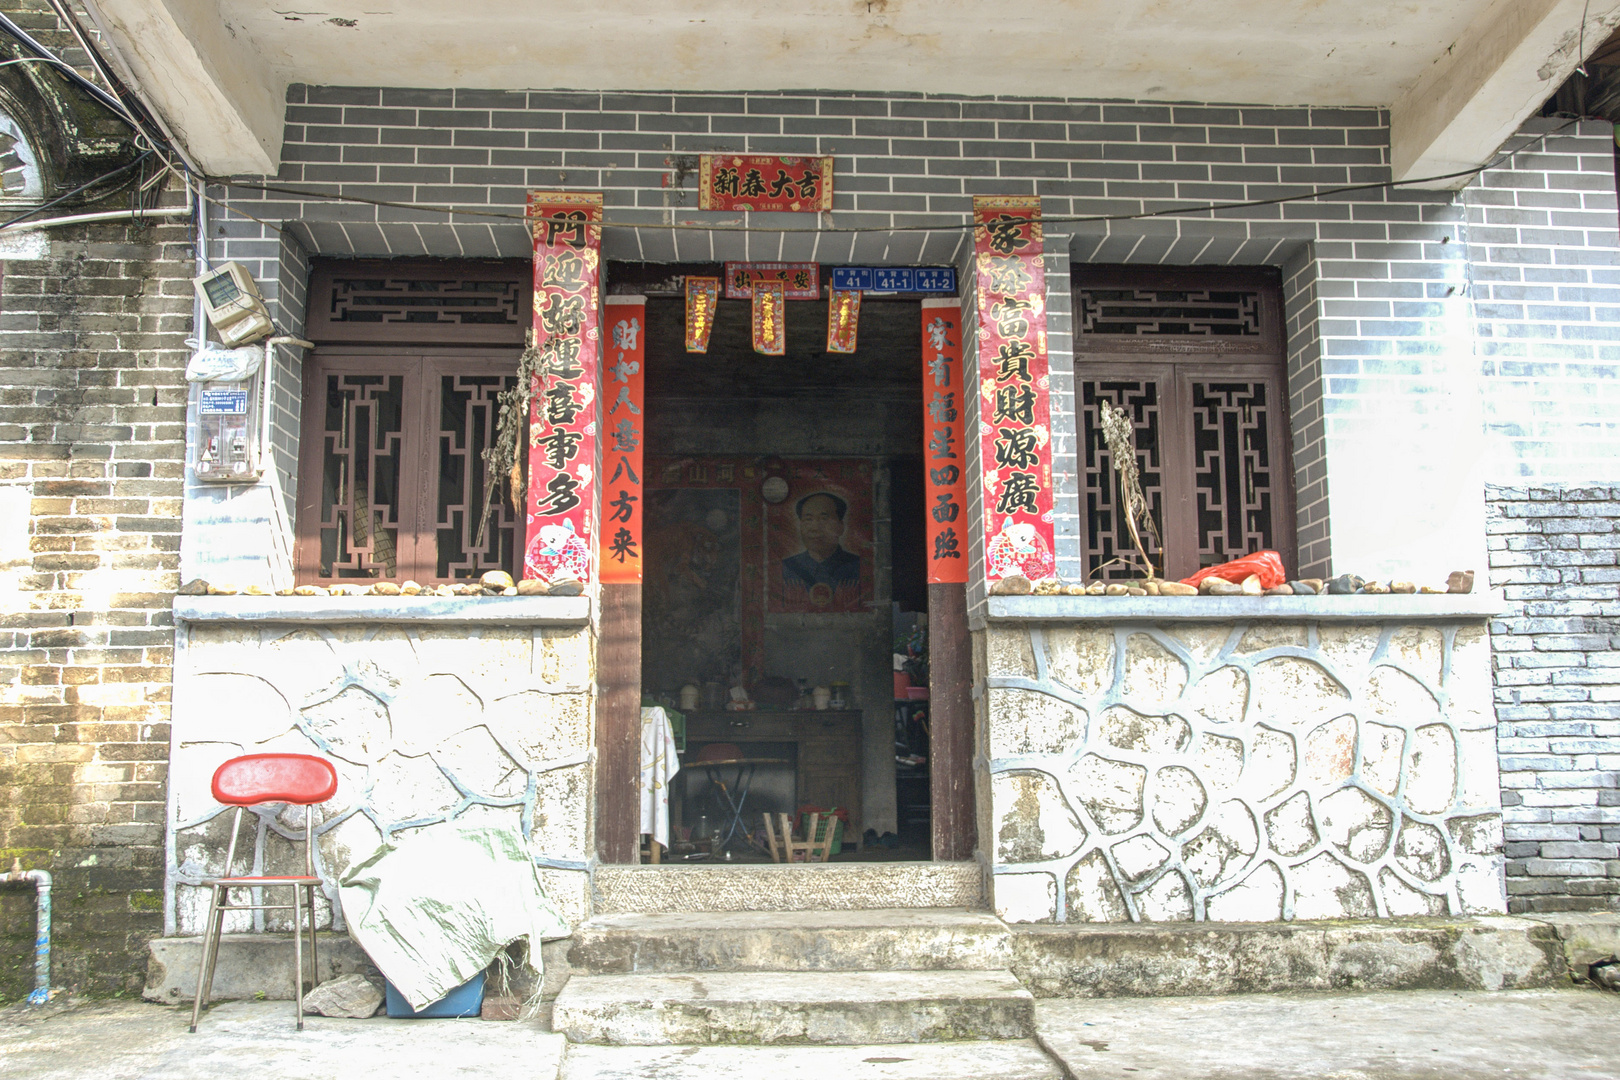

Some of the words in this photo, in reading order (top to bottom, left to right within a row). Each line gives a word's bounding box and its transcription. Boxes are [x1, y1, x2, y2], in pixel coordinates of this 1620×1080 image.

[713, 167, 820, 199] 新春大吉
[846, 277, 861, 287] 41
[881, 278, 908, 289] 41-1
[922, 278, 950, 289] 41-2
[536, 211, 588, 518] 門迎好運喜事多
[985, 213, 1040, 515] 家添富貴財源廣
[608, 317, 641, 562] 財如人意八方来
[926, 316, 962, 561] 家有福星四面照
